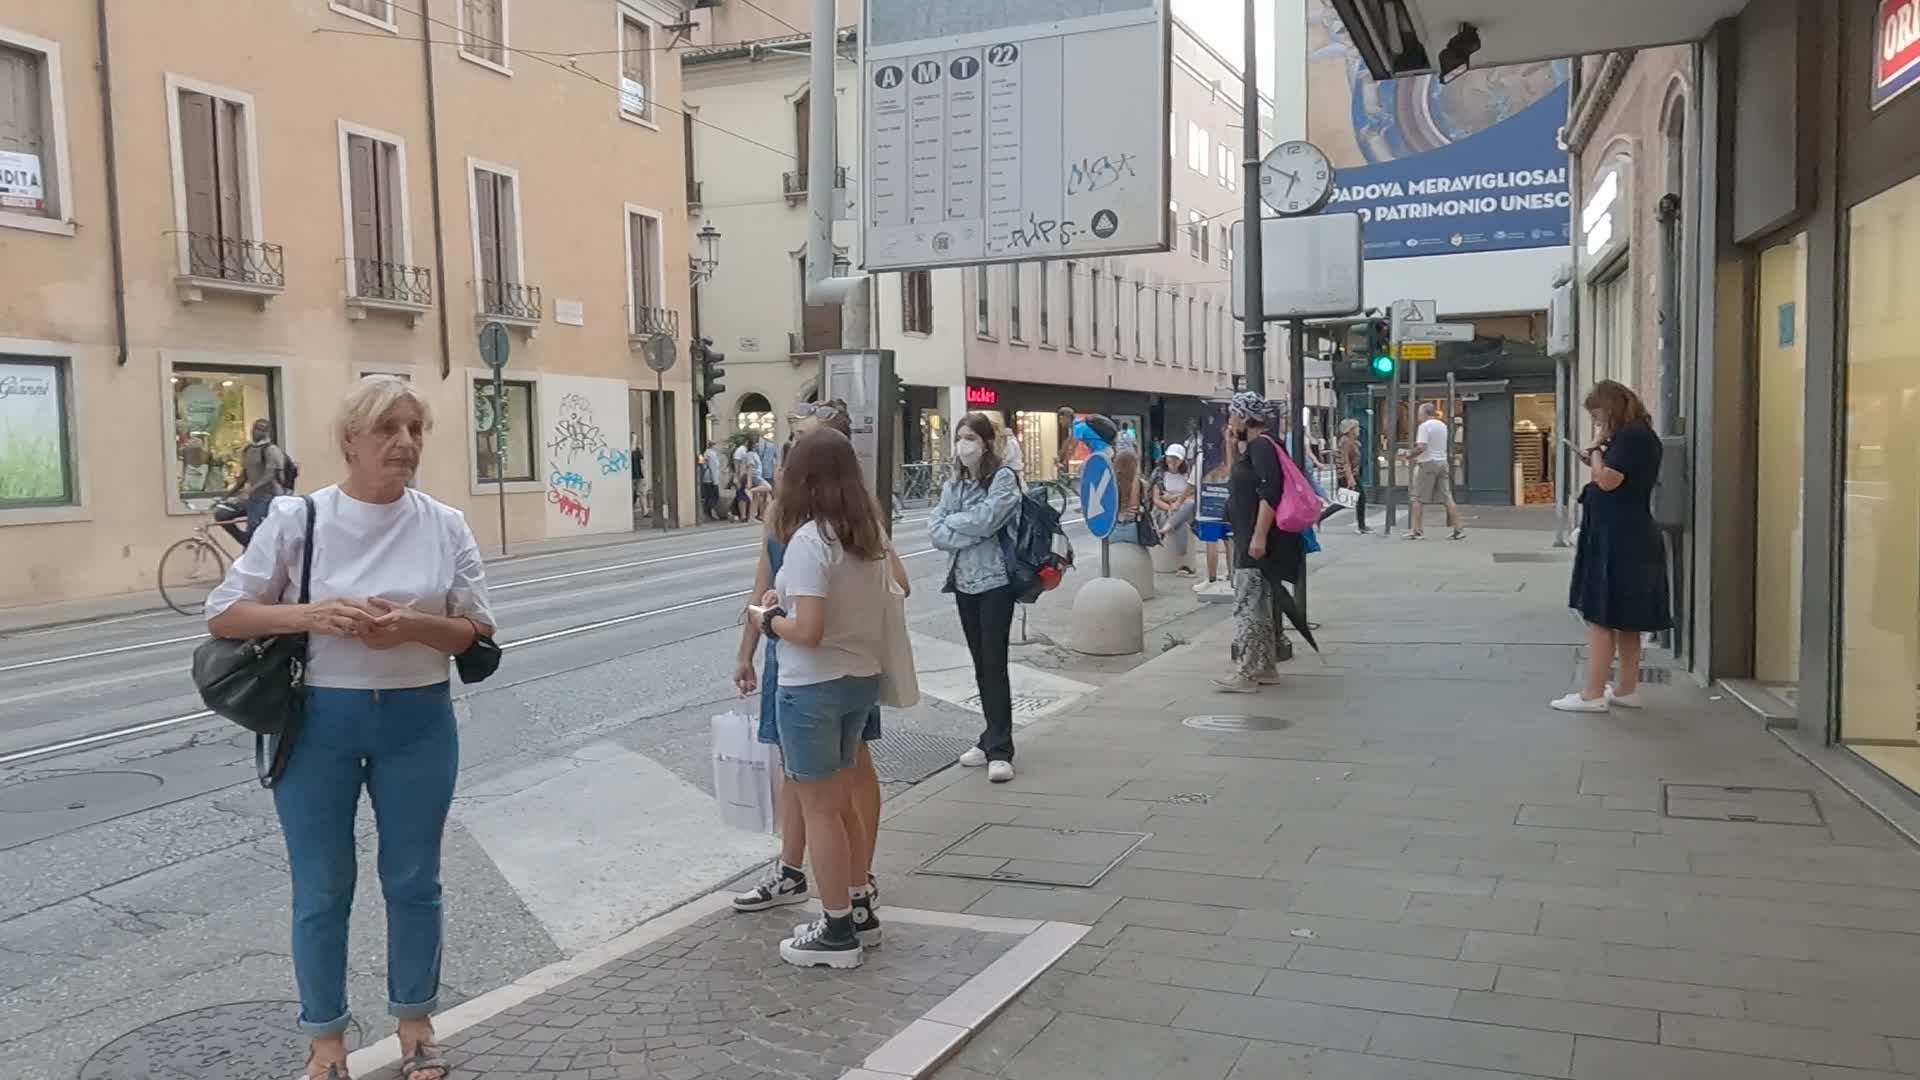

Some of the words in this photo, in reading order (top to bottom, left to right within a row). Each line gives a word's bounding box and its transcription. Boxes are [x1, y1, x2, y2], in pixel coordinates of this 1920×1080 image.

[992, 45, 1014, 66] 22
[1287, 145, 1301, 155] 12
[1316, 170, 1327, 180] 3
[1328, 182, 1404, 204] PADOVA
[1408, 167, 1566, 197] MERAVIGLIOSA!
[1289, 200, 1299, 210] 6
[1374, 198, 1497, 223] PATRIMONIO
